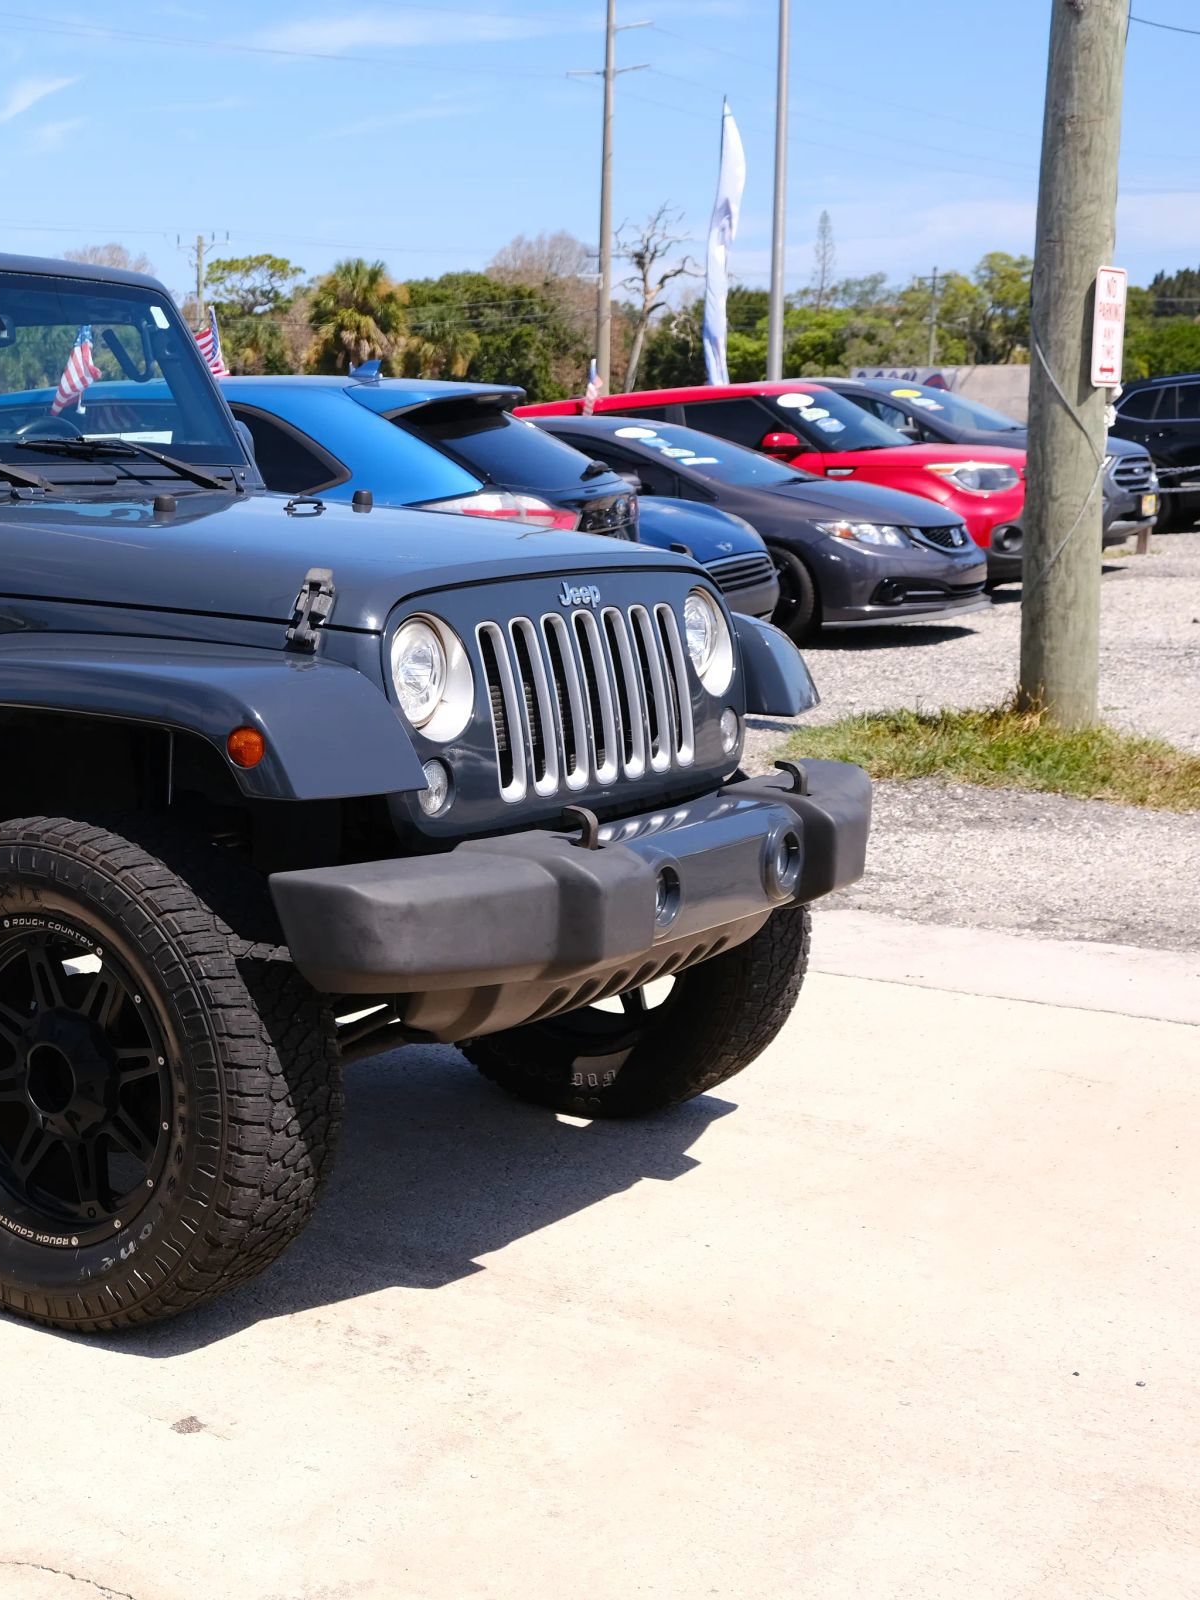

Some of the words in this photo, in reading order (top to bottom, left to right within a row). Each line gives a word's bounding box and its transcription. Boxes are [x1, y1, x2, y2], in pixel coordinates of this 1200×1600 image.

[560, 581, 601, 608] Jeep
[12, 918, 45, 927] ROUGH
[47, 921, 94, 947] COUNTRY
[36, 1233, 69, 1246] ROUGH
